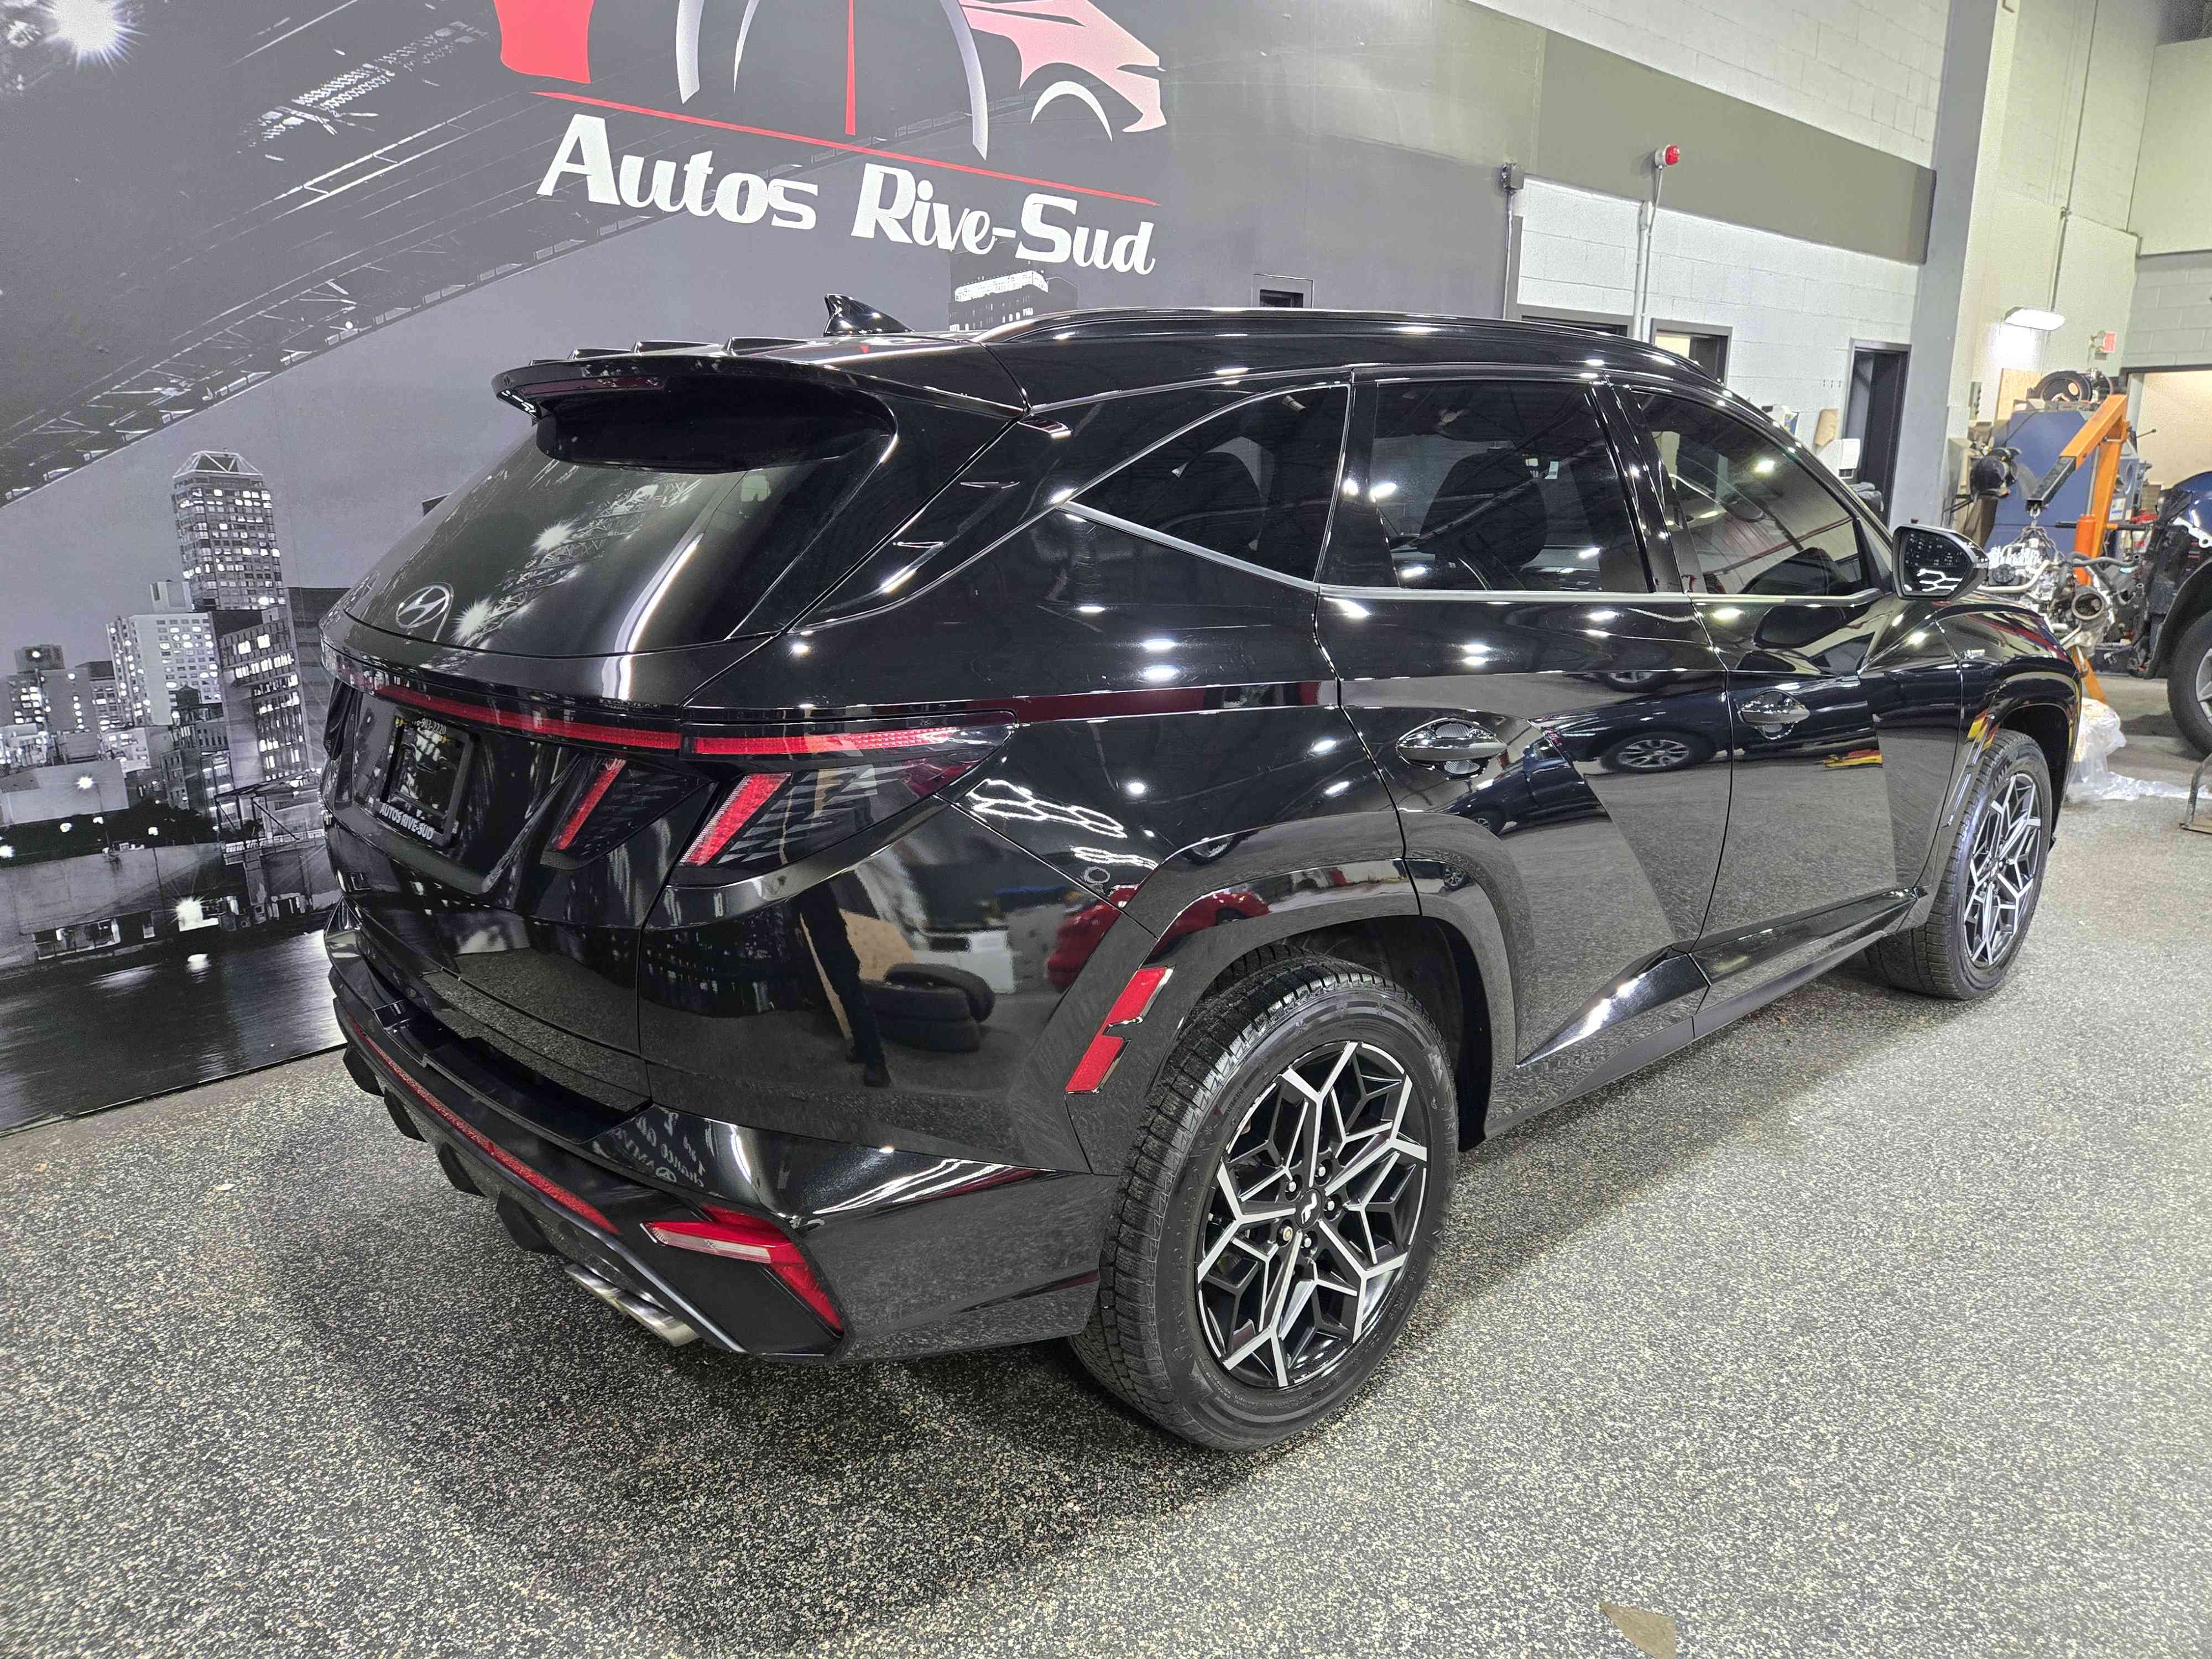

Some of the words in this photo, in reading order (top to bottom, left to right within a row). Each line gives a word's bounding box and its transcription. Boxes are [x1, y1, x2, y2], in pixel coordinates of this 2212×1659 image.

[536, 113, 818, 230] Autos
[850, 163, 1156, 275] Rive-Sud
[379, 803, 404, 823] AUTOS
[400, 813, 435, 840] RIVE-SUD
